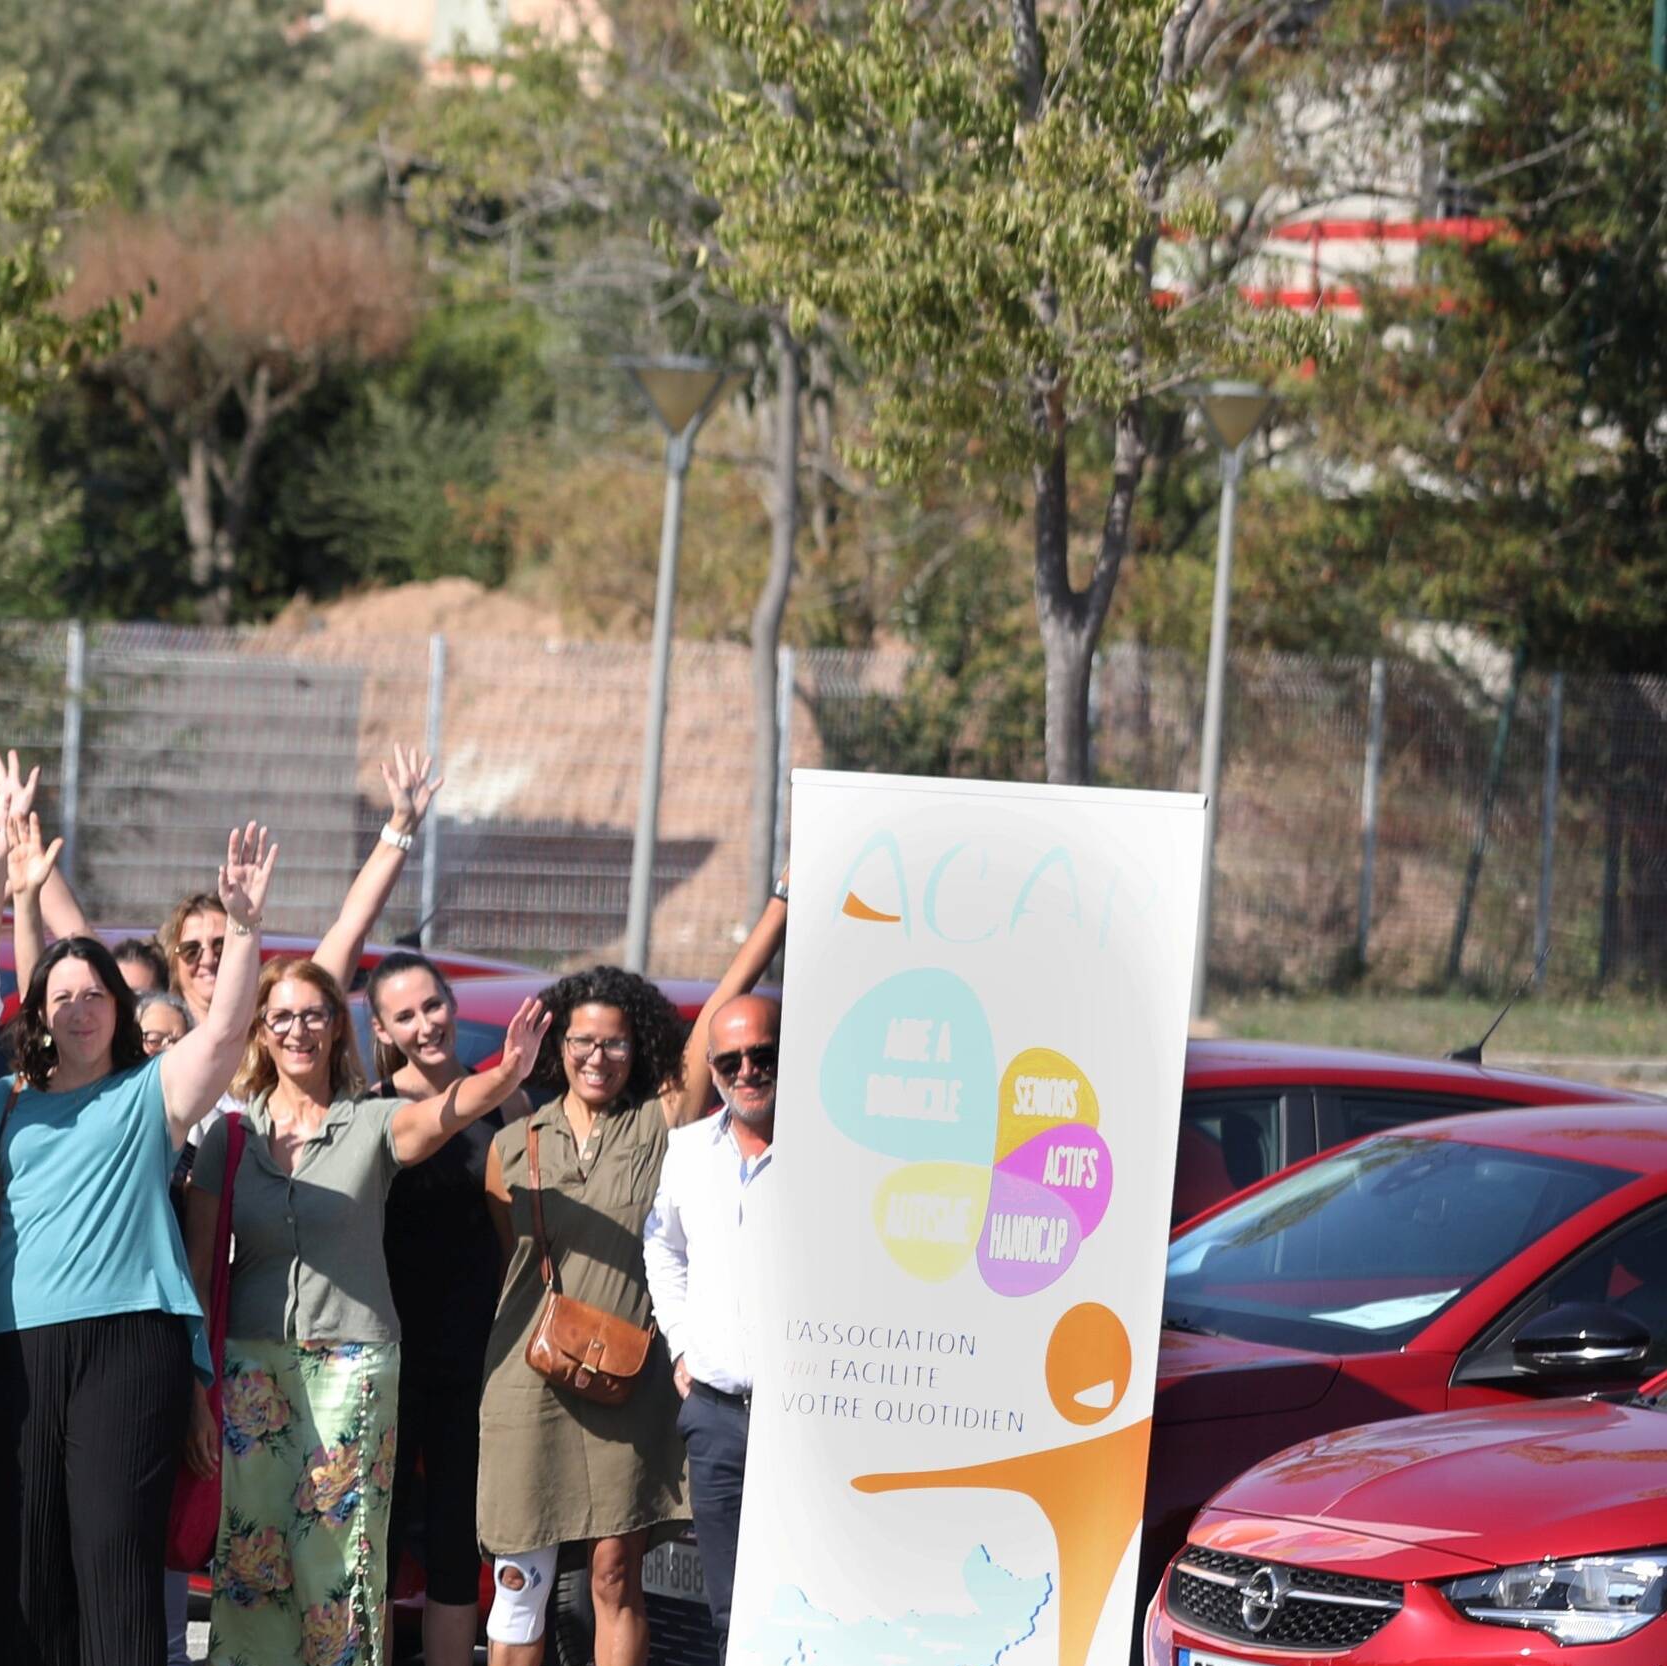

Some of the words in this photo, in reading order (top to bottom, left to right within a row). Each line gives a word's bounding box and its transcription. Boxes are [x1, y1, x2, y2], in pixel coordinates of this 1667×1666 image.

[1013, 1075, 1079, 1119] SENIORS
[1042, 1145, 1099, 1189] ACTIFS
[988, 1212, 1068, 1265] HANDICAP
[786, 1319, 976, 1356] L'ASSOCIATION
[830, 1359, 941, 1389] FACILITE
[781, 1391, 864, 1420] VOTRE
[875, 1399, 1024, 1433] QUOTIDIEN
